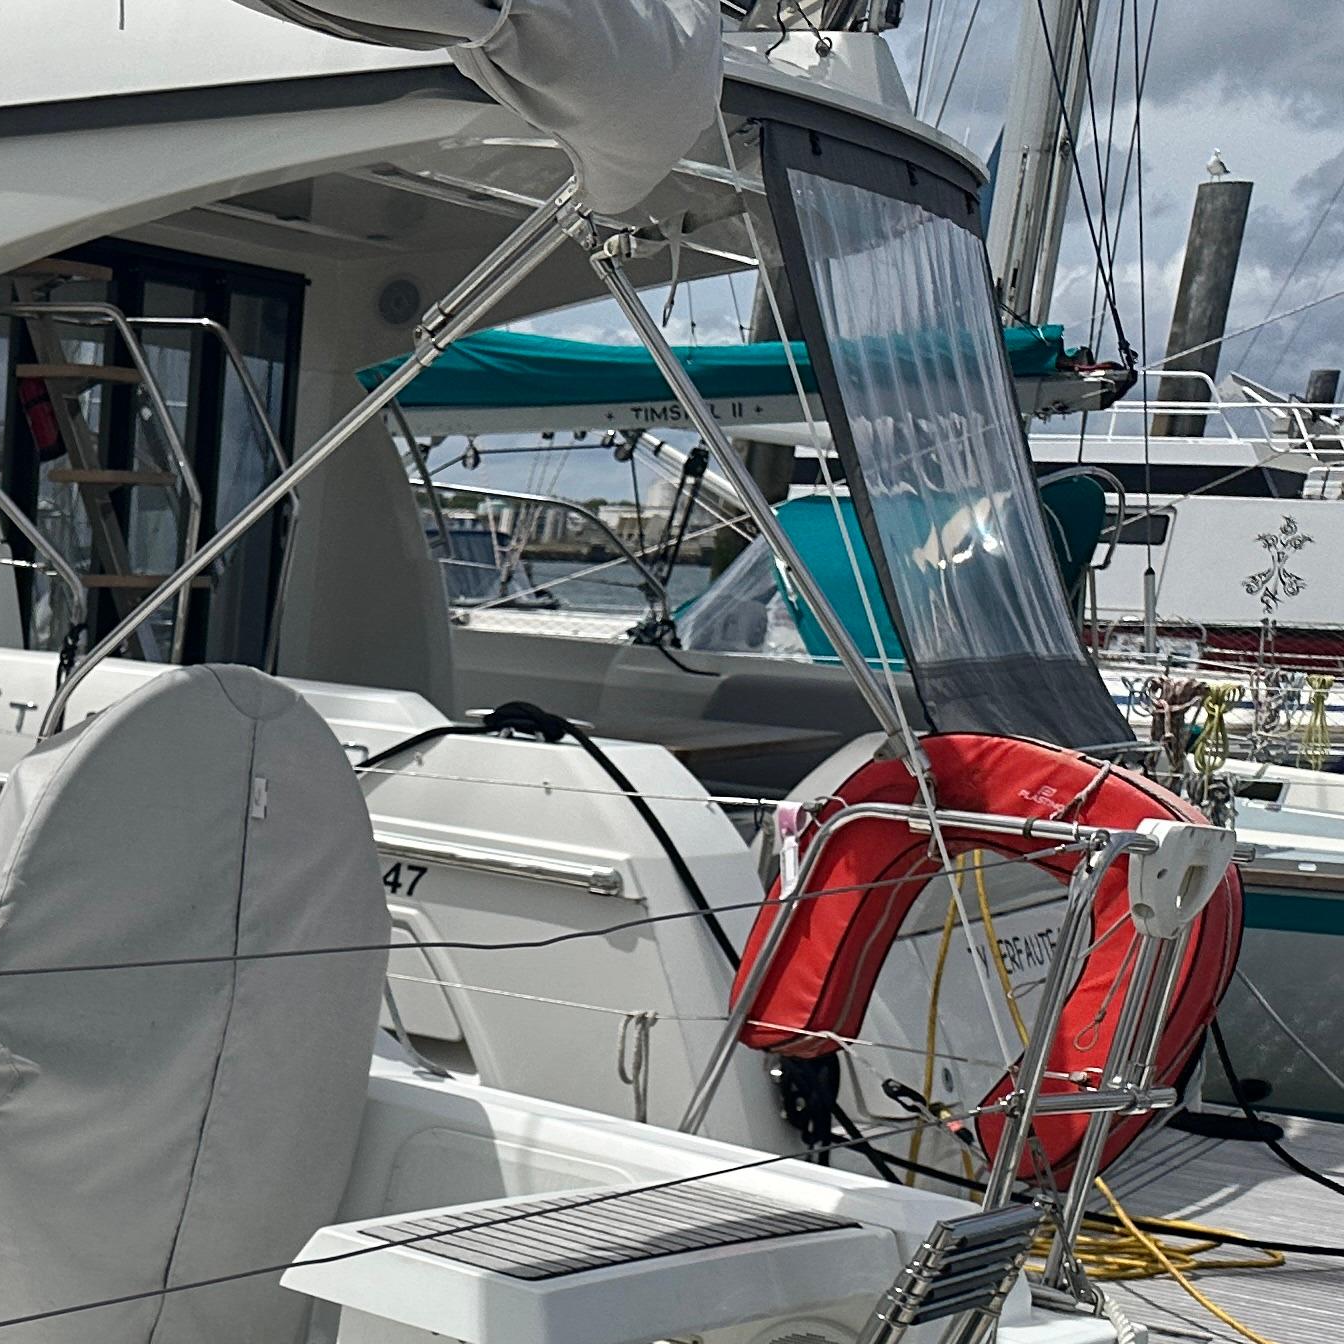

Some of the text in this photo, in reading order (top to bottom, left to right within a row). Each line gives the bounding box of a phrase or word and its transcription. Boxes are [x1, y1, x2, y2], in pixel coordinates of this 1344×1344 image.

[631, 404, 720, 422] TIMSL
[382, 862, 428, 897] 47
[996, 928, 1062, 975] ERFAUT
